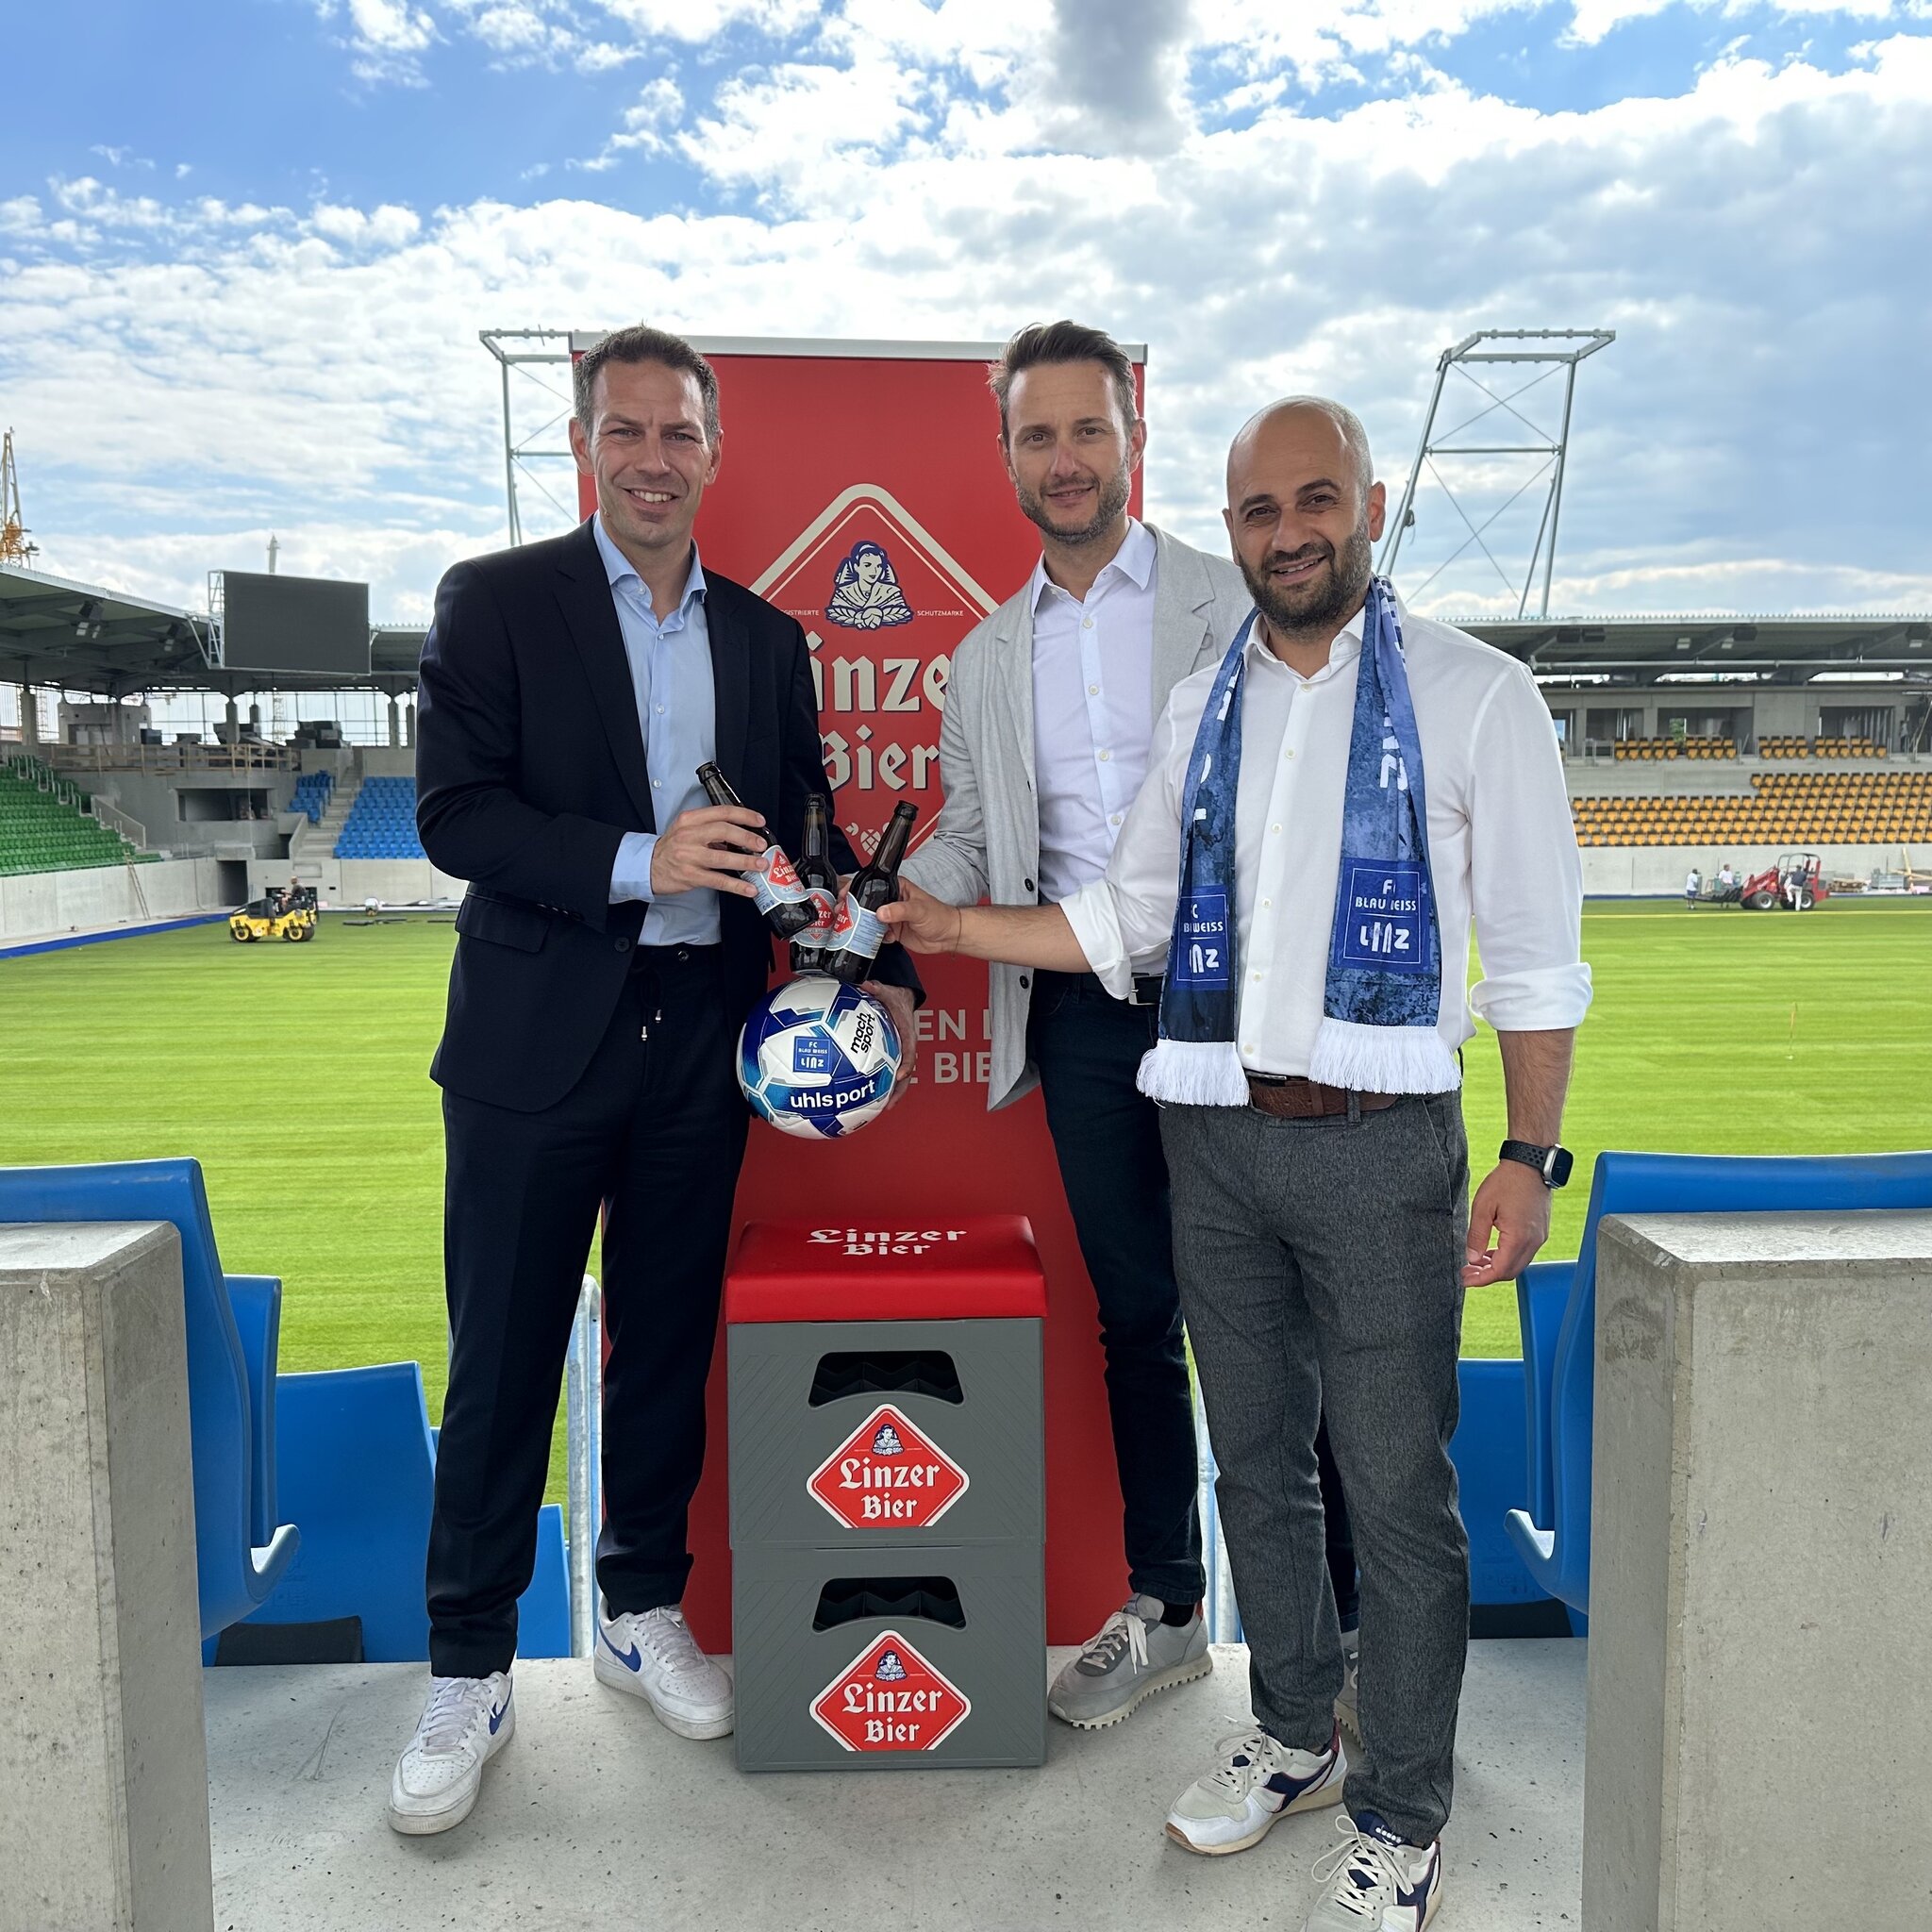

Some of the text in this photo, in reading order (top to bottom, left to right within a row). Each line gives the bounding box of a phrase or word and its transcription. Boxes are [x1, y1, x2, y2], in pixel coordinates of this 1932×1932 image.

[805, 630, 952, 713] inze
[1382, 878, 1396, 895] F
[817, 909, 832, 919] zer
[1355, 896, 1387, 909] BLAU
[850, 1012, 869, 1054] mach
[860, 1013, 875, 1054] sport
[913, 1008, 966, 1041] EN
[800, 1057, 824, 1069] LINZ
[934, 1052, 991, 1084] BIE
[807, 1228, 968, 1244] Linzer
[841, 1241, 931, 1256] Bier
[839, 1457, 941, 1490] Linzer
[860, 1491, 918, 1520] Bier
[841, 1682, 943, 1714] Linzer
[864, 1716, 921, 1742] Bier
